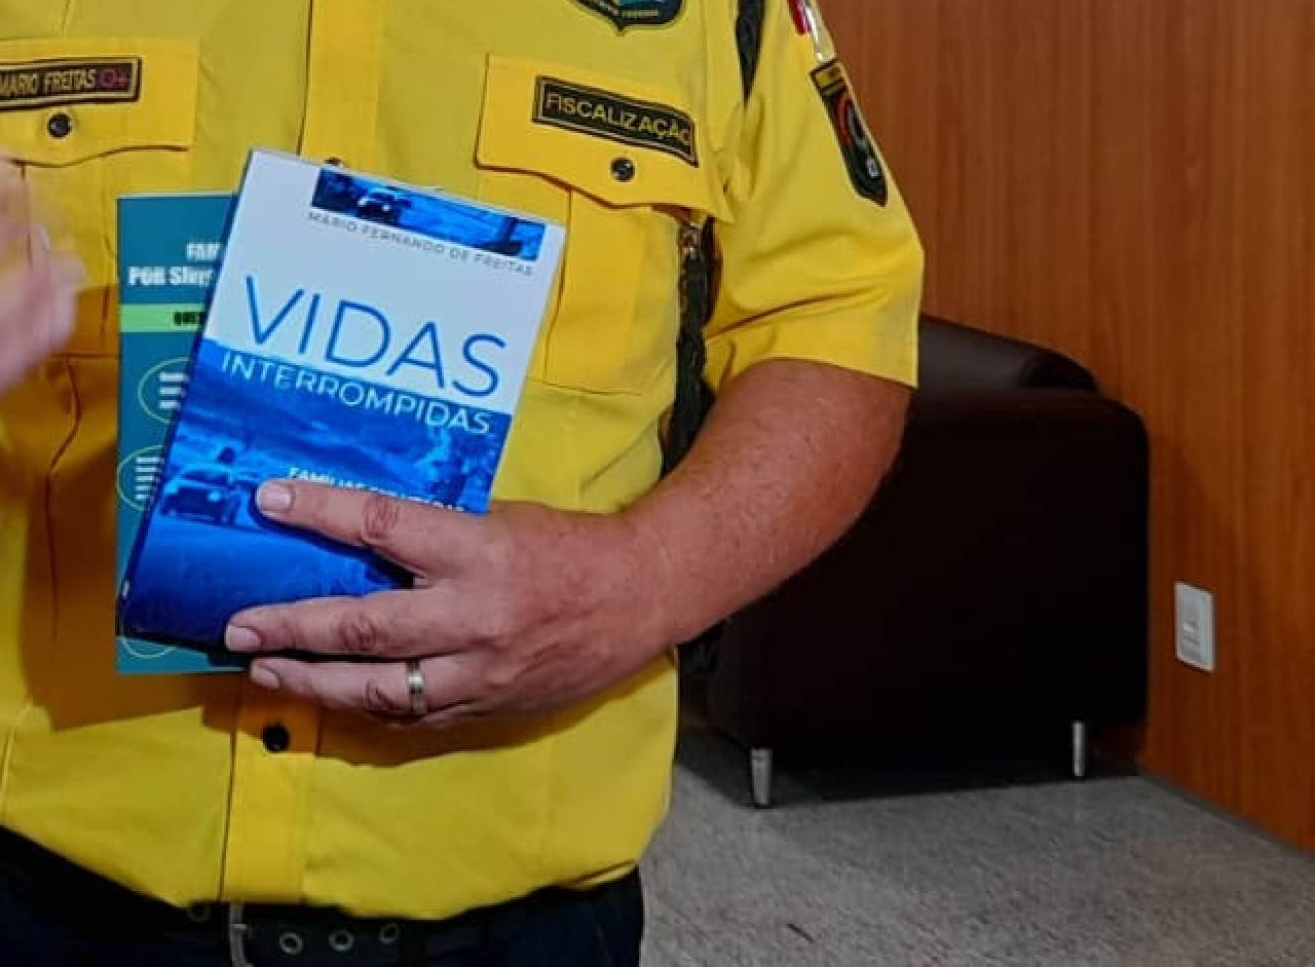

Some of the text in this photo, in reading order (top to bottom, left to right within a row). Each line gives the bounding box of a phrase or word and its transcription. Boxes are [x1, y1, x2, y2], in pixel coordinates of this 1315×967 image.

[44, 68, 97, 92] FREITAS
[361, 222, 445, 255] FERNANDO
[449, 247, 469, 262] DE
[473, 249, 534, 277] FREITAS
[245, 274, 507, 398] VIDAS
[221, 349, 491, 435] INTERROMPIDAS
